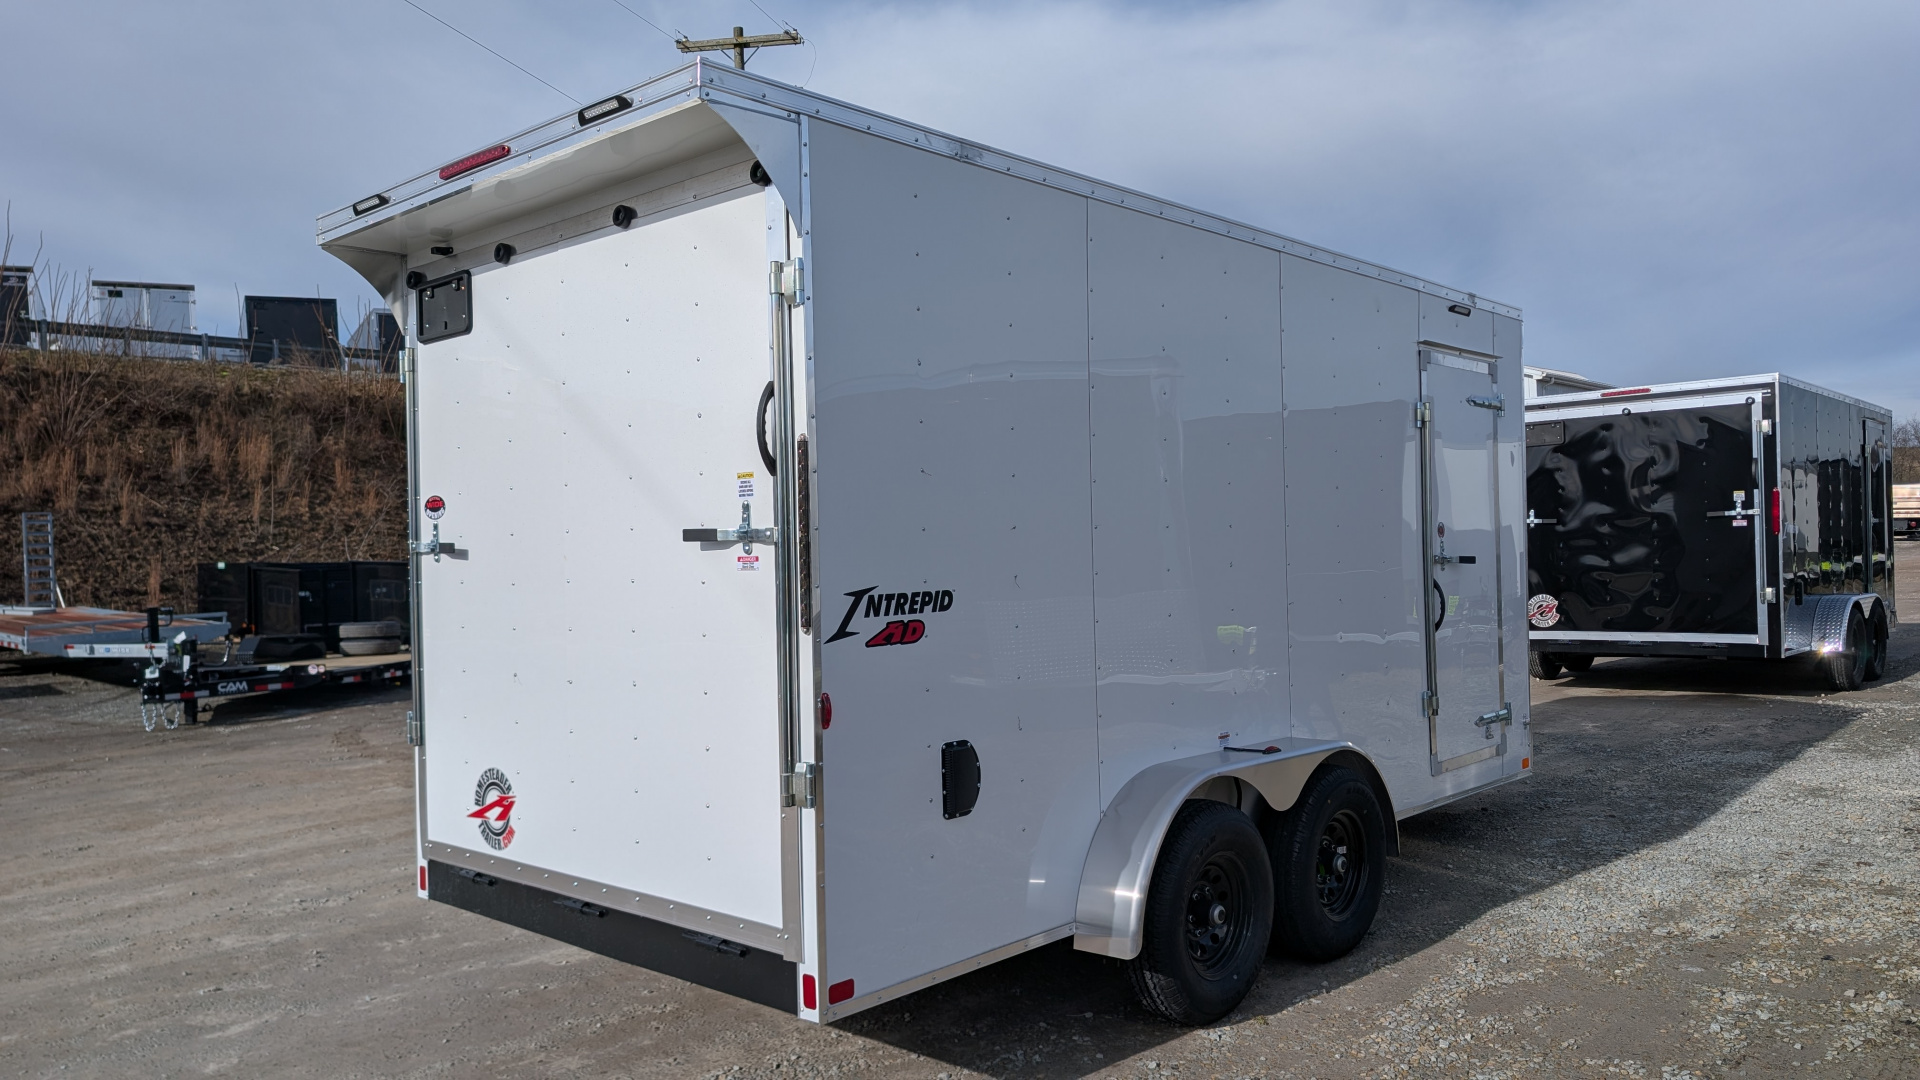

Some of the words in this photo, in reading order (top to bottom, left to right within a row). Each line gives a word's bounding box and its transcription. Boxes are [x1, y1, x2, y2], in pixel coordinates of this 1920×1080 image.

[426, 500, 444, 509] WIDE
[823, 585, 954, 645] INTREPID
[217, 680, 249, 693] CAM
[474, 767, 513, 807] HOMESTEADER
[478, 824, 516, 851] TRAILER.COM
